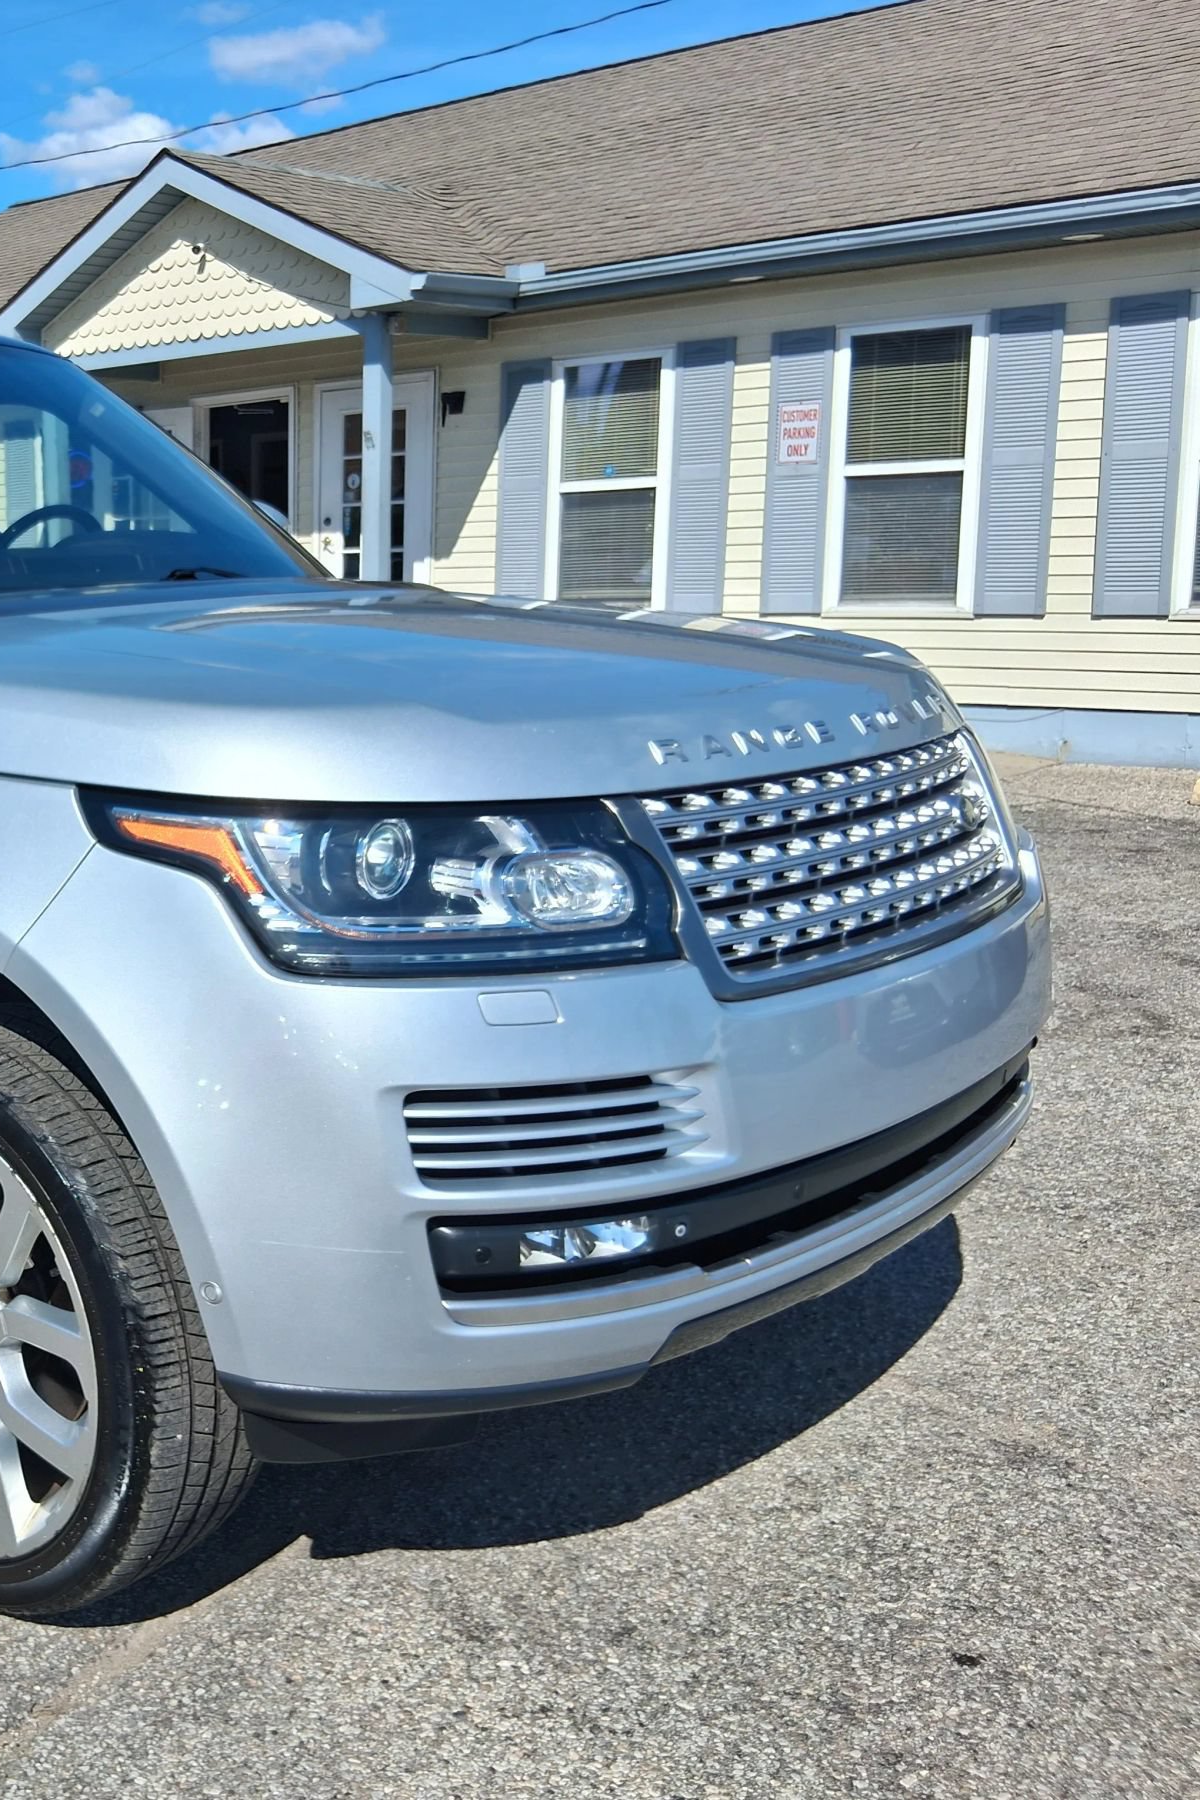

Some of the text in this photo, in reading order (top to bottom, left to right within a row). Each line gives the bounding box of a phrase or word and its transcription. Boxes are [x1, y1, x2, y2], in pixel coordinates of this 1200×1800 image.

[782, 408, 818, 423] CUSTOMER
[782, 426, 816, 440] PARKING
[786, 443, 809, 457] ONLY
[647, 719, 836, 766] RANGE
